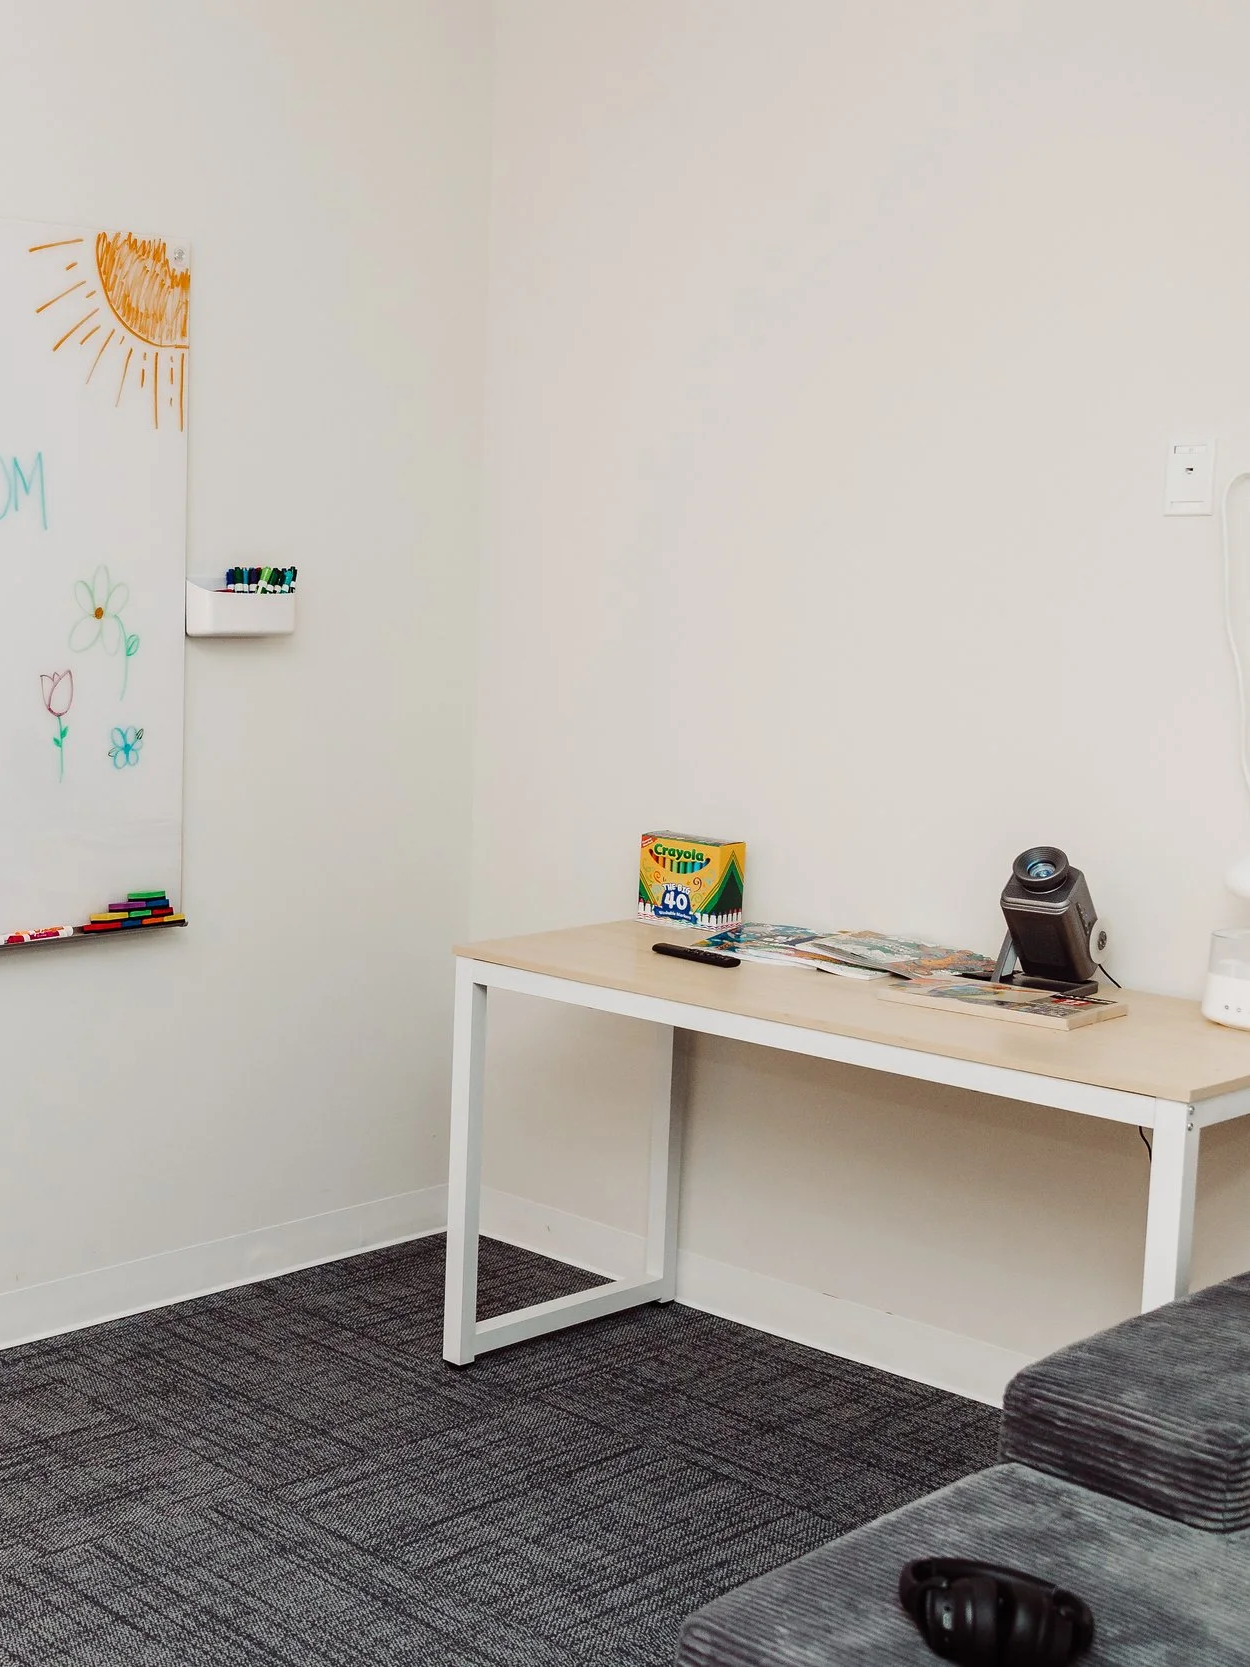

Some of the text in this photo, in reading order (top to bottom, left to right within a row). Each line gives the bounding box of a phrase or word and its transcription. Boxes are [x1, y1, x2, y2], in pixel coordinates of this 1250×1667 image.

[654, 843, 704, 861] Crayola
[662, 883, 691, 895] THE BIG
[664, 891, 688, 911] 40
